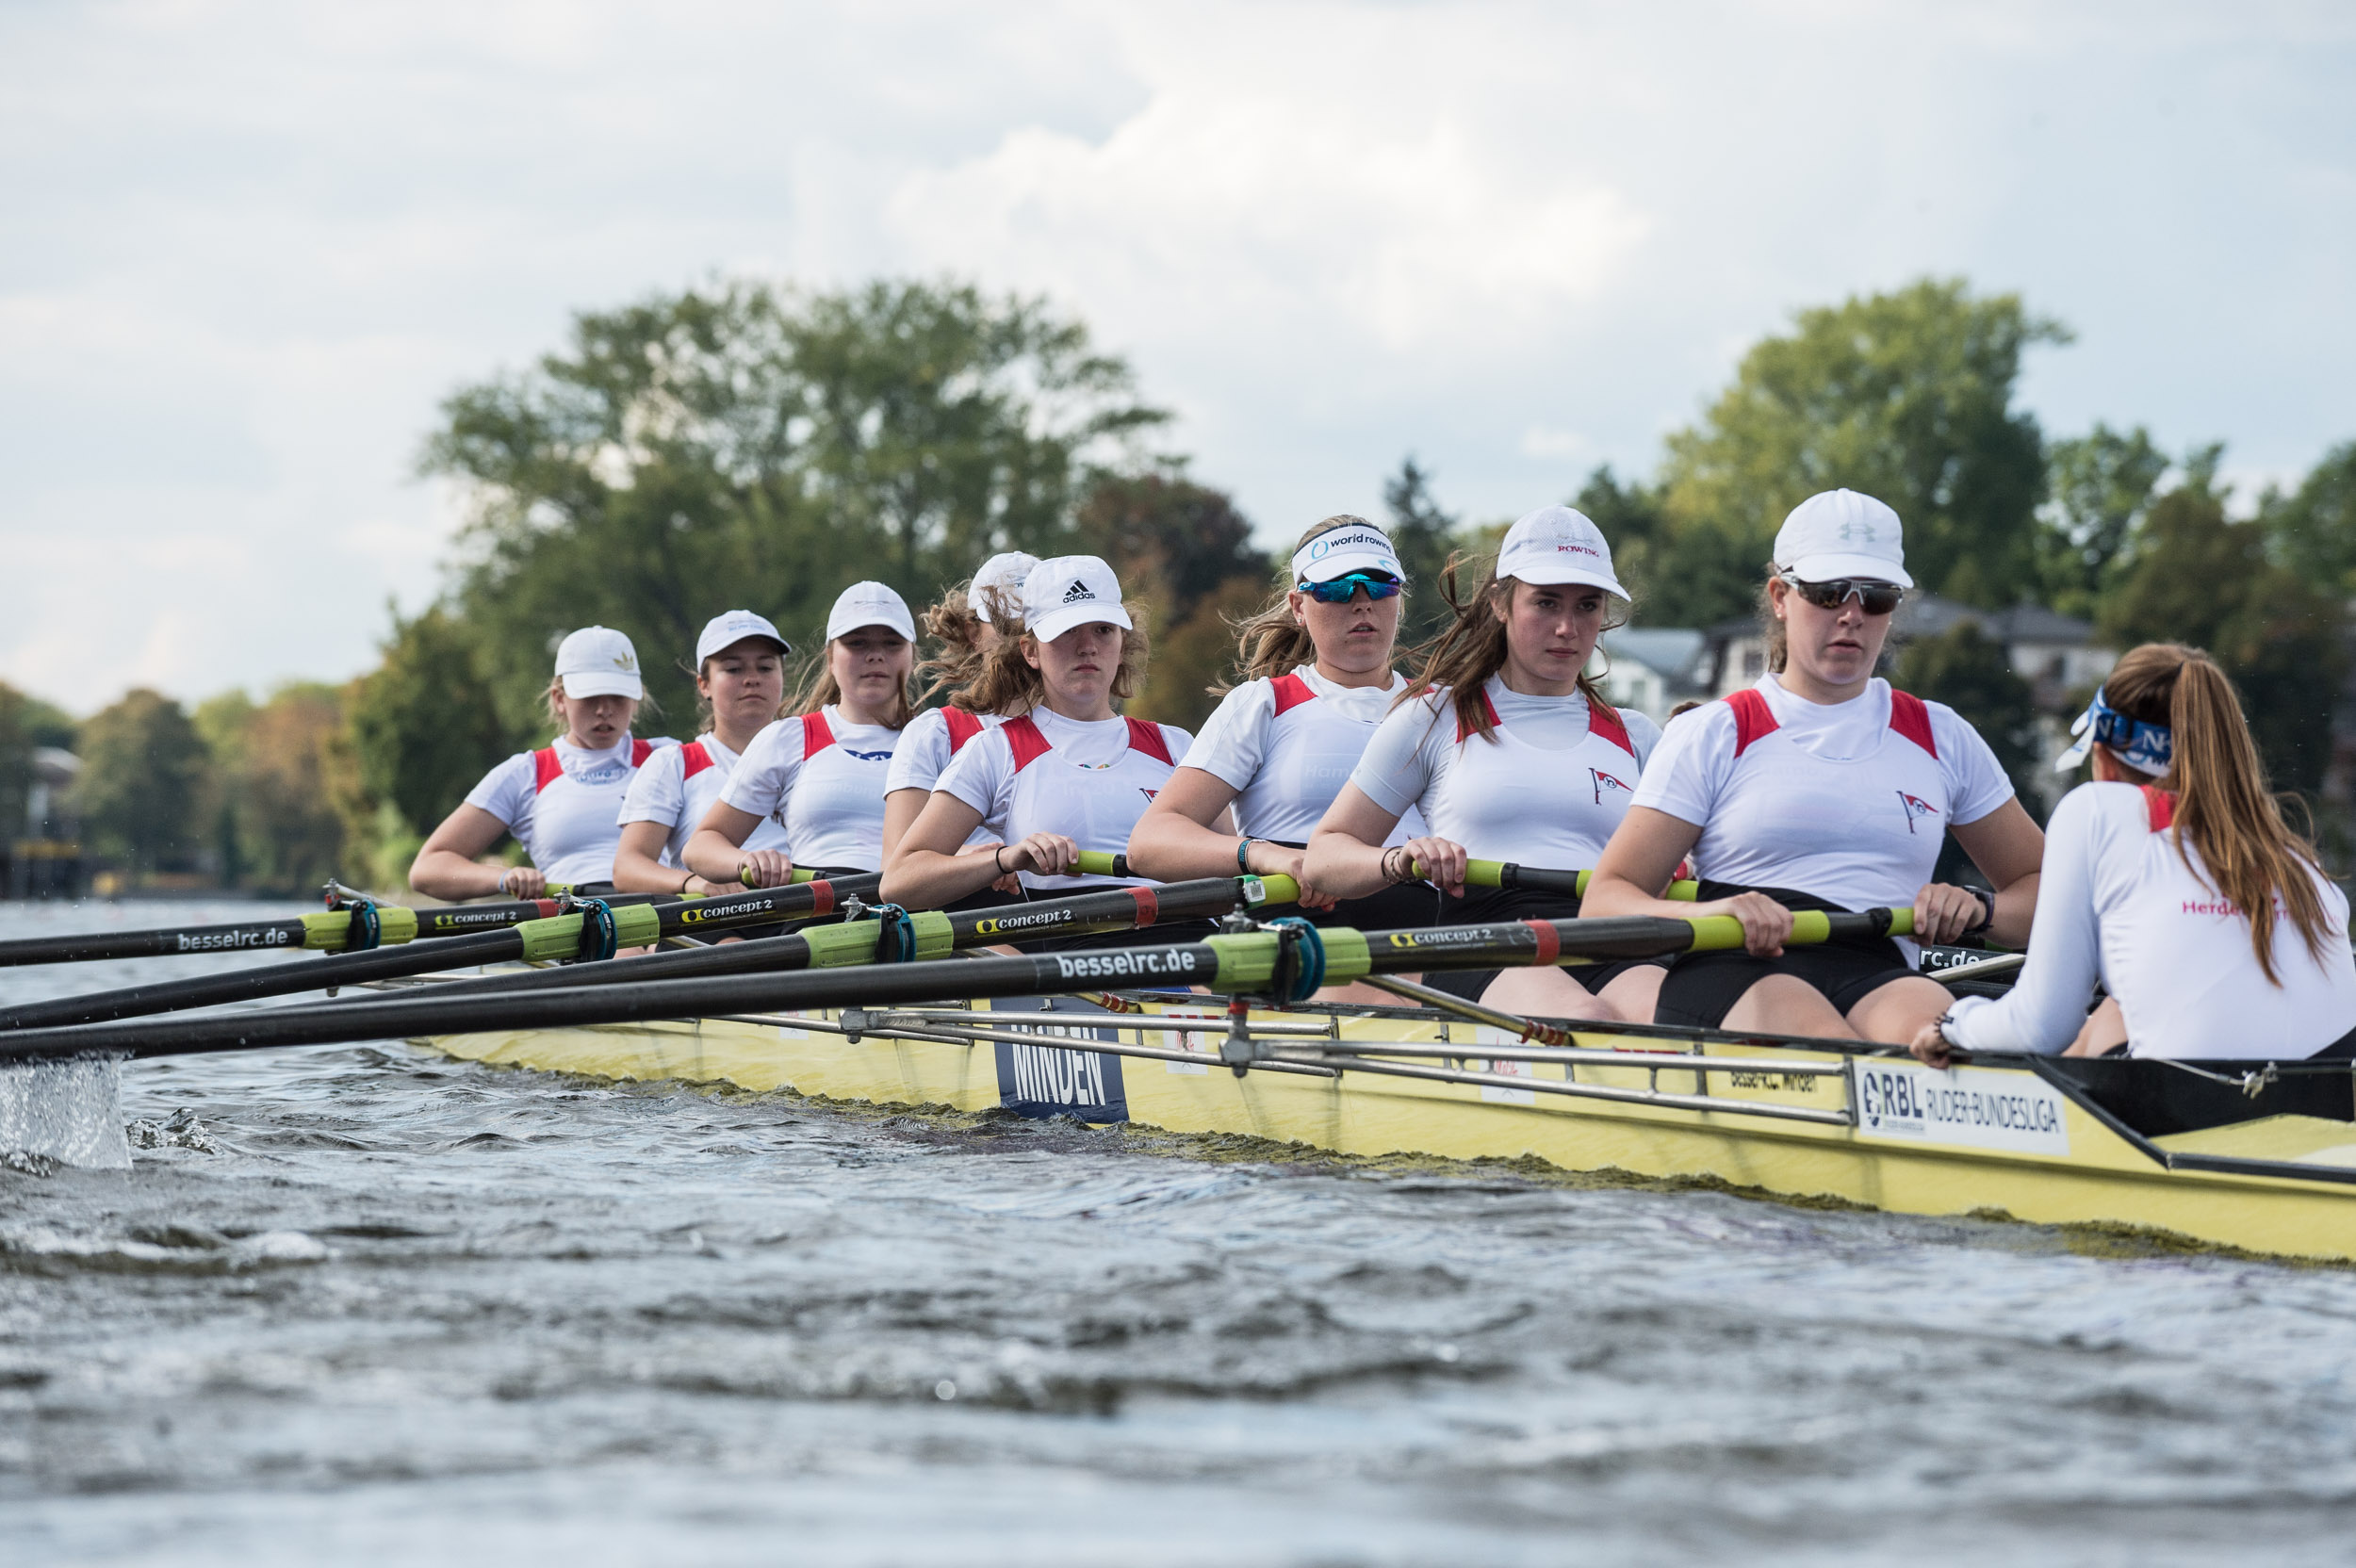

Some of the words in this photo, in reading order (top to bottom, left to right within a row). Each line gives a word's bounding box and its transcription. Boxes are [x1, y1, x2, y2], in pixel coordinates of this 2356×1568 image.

[1330, 533, 1364, 547] world
[1557, 545, 1599, 558] ROWING
[1062, 591, 1096, 604] adidas
[454, 911, 507, 924] concept
[509, 910, 517, 921] 2
[703, 900, 763, 920] concept
[763, 899, 773, 909] 2
[998, 910, 1061, 929] concept
[1062, 909, 1072, 921] 2
[177, 927, 288, 951] besselrc.de
[1415, 929, 1480, 943] concept
[1481, 928, 1494, 939] 2
[1055, 948, 1196, 978] besselrc.de
[1010, 1022, 1106, 1106] MINDEN
[1881, 1073, 1923, 1119] RBL
[1925, 1087, 2060, 1133] RUDER-BUNDESLIGA
